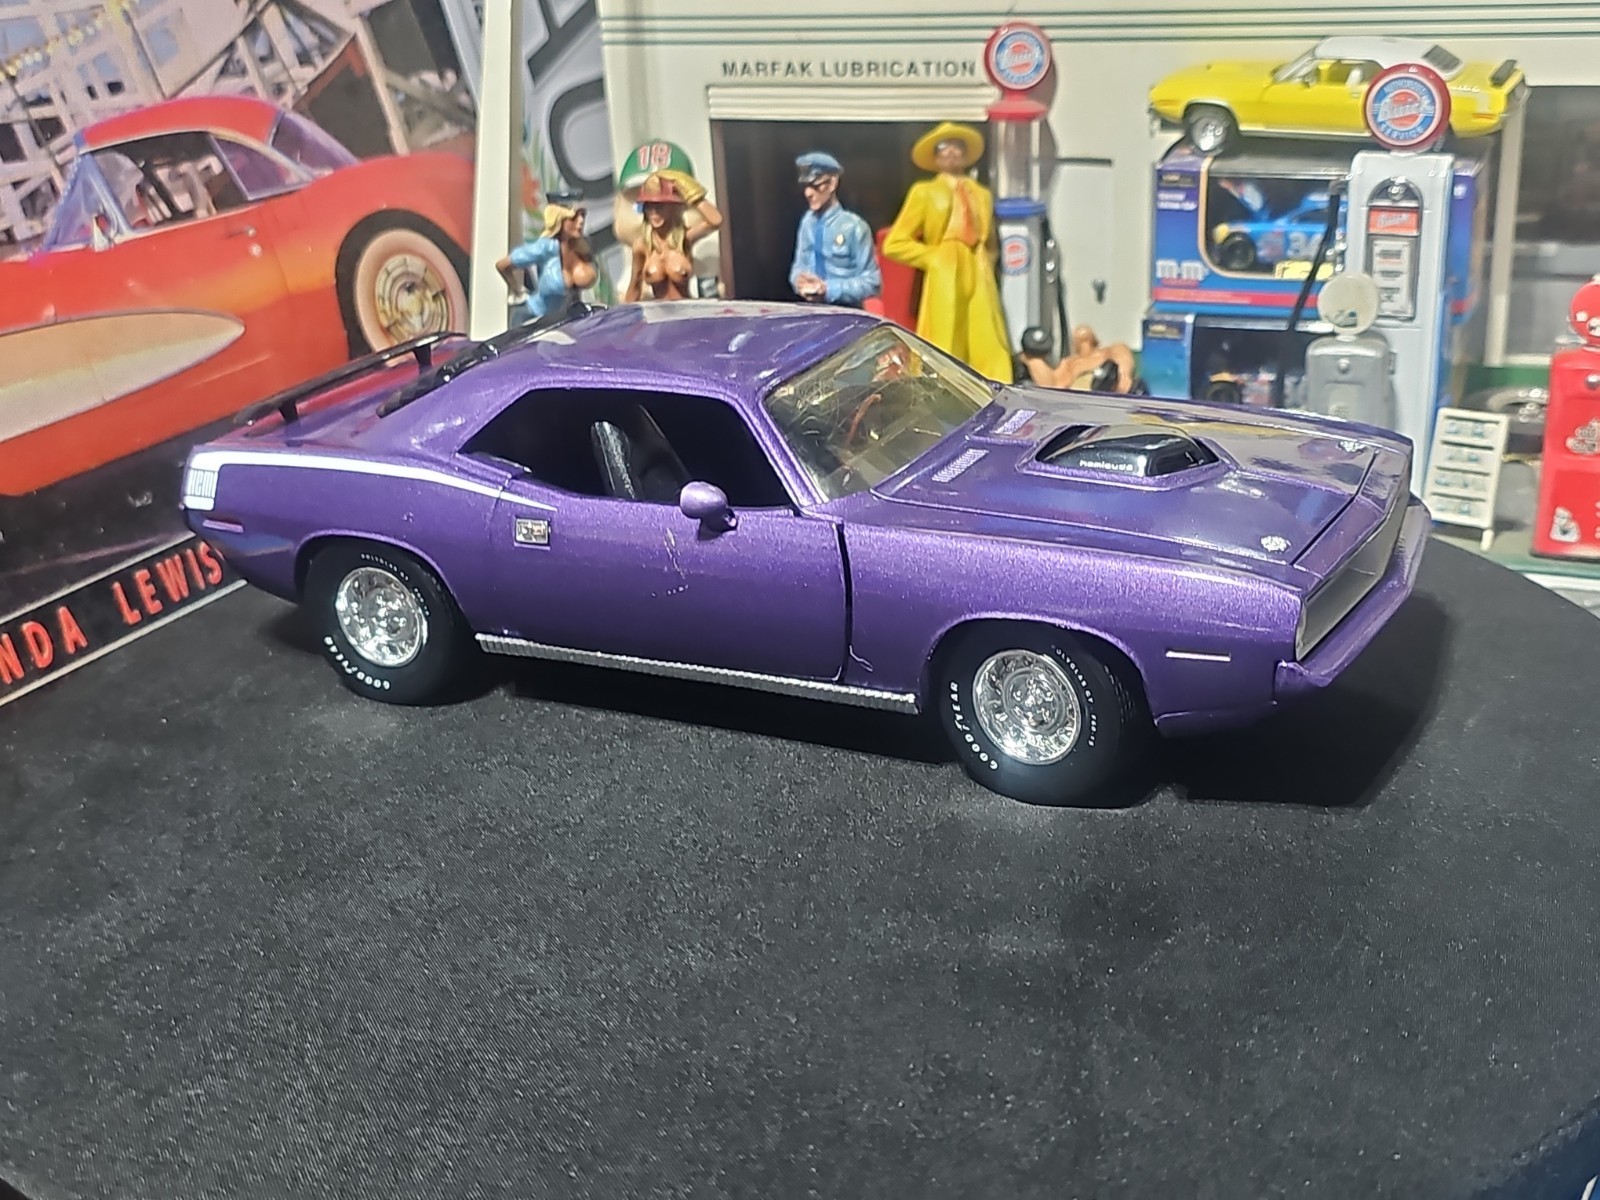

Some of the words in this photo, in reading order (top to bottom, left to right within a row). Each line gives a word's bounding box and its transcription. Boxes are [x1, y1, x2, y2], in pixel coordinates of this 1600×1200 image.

[722, 61, 813, 78] MARFAK
[821, 60, 976, 78] LUBRICATION
[112, 541, 223, 626] LEWIS
[949, 681, 999, 771] GOODYEAR
